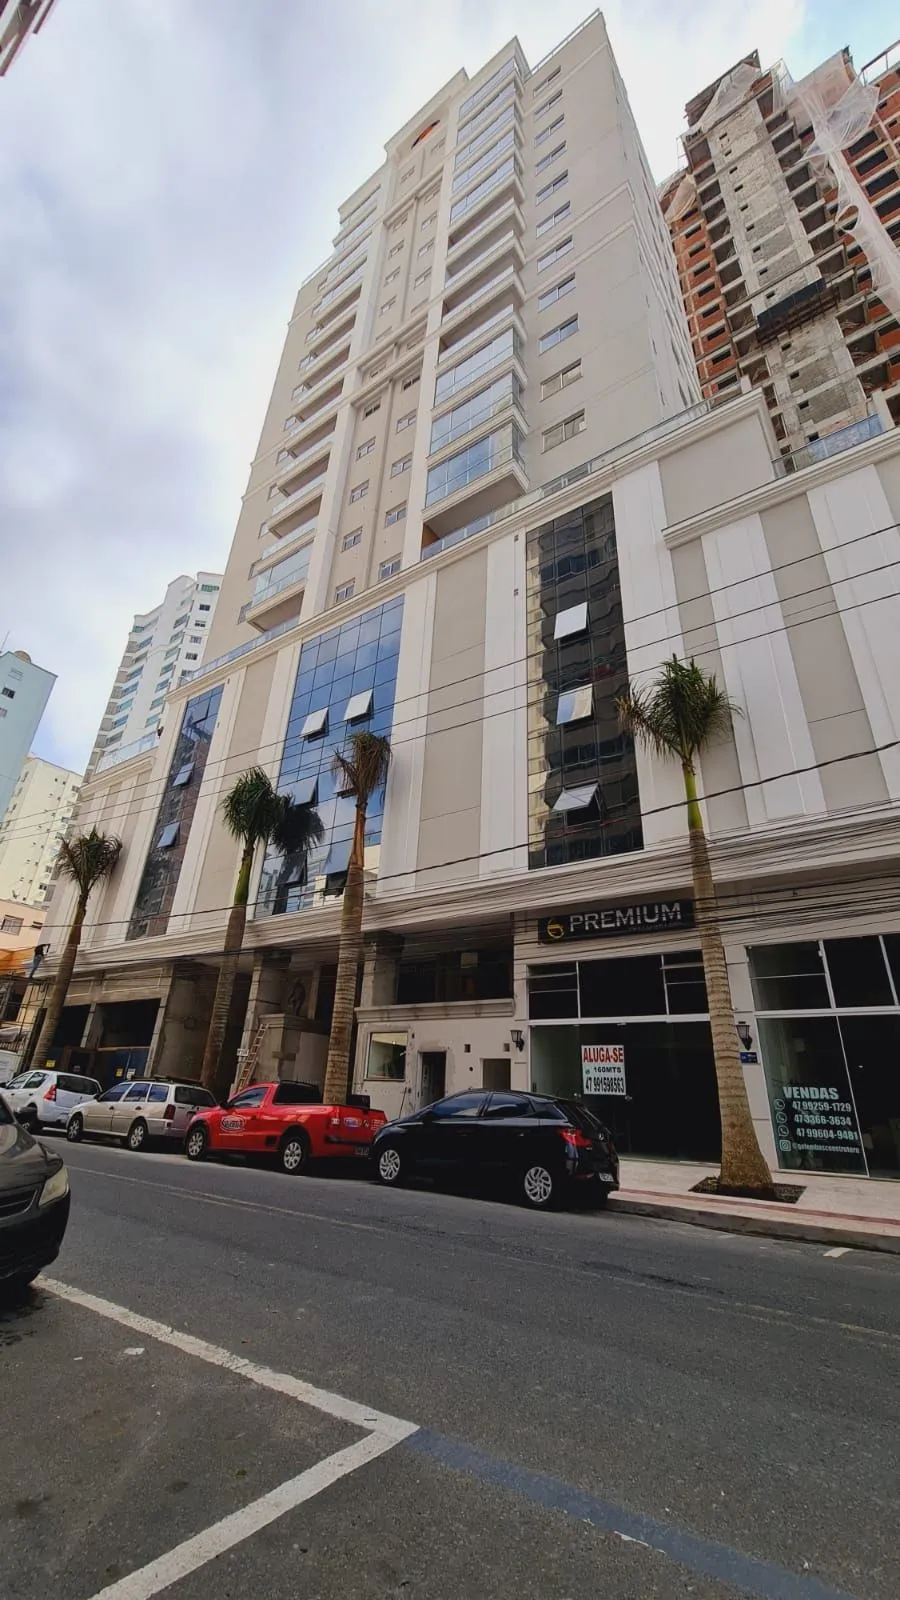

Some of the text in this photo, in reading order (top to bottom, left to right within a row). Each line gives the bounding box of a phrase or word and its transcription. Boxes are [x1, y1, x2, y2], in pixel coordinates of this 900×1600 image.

[569, 902, 682, 932] PREMIUM
[583, 1047, 624, 1063] ALUGA-SE
[585, 1076, 592, 1092] 47
[782, 1086, 839, 1100] VENDAS
[792, 1100, 801, 1110] 47
[794, 1114, 803, 1123] 47
[796, 1127, 805, 1137] 47
